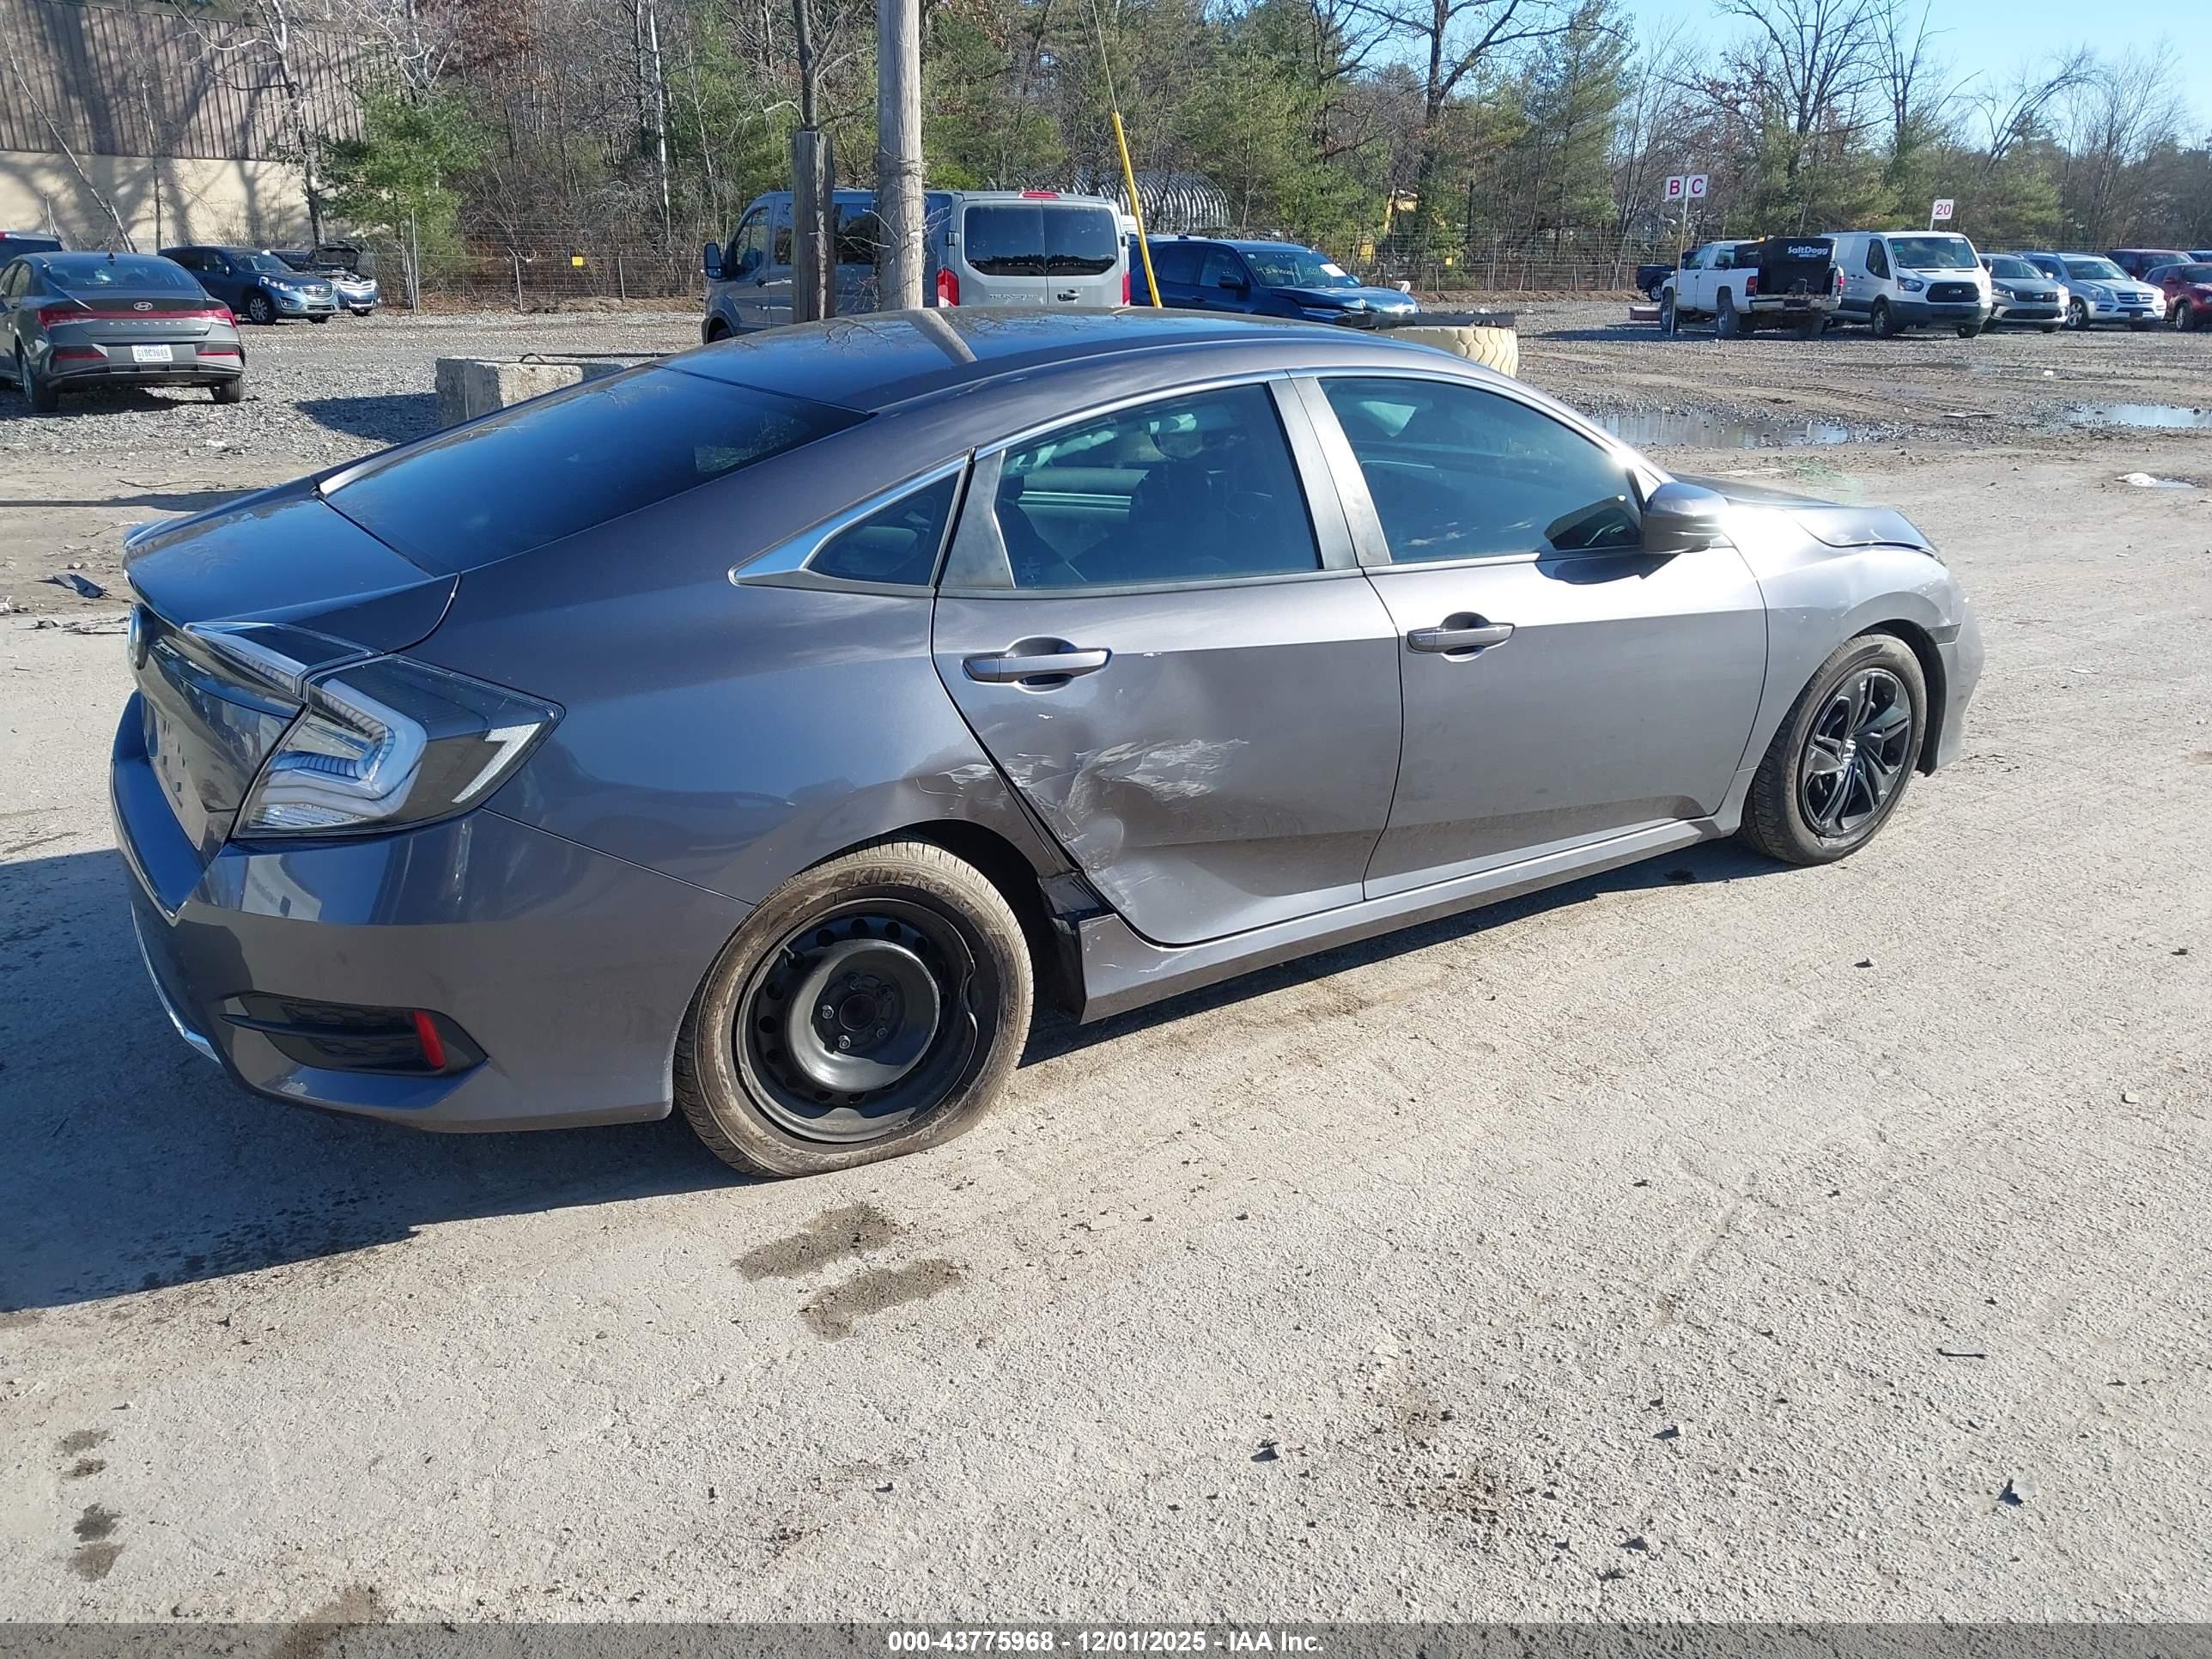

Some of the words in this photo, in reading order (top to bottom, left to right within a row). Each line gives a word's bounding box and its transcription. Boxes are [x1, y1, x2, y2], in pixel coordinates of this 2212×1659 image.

[1669, 179, 1680, 195] B
[1692, 178, 1704, 194] C
[1936, 204, 1952, 215] 20
[1787, 246, 1829, 255] SaltDogg
